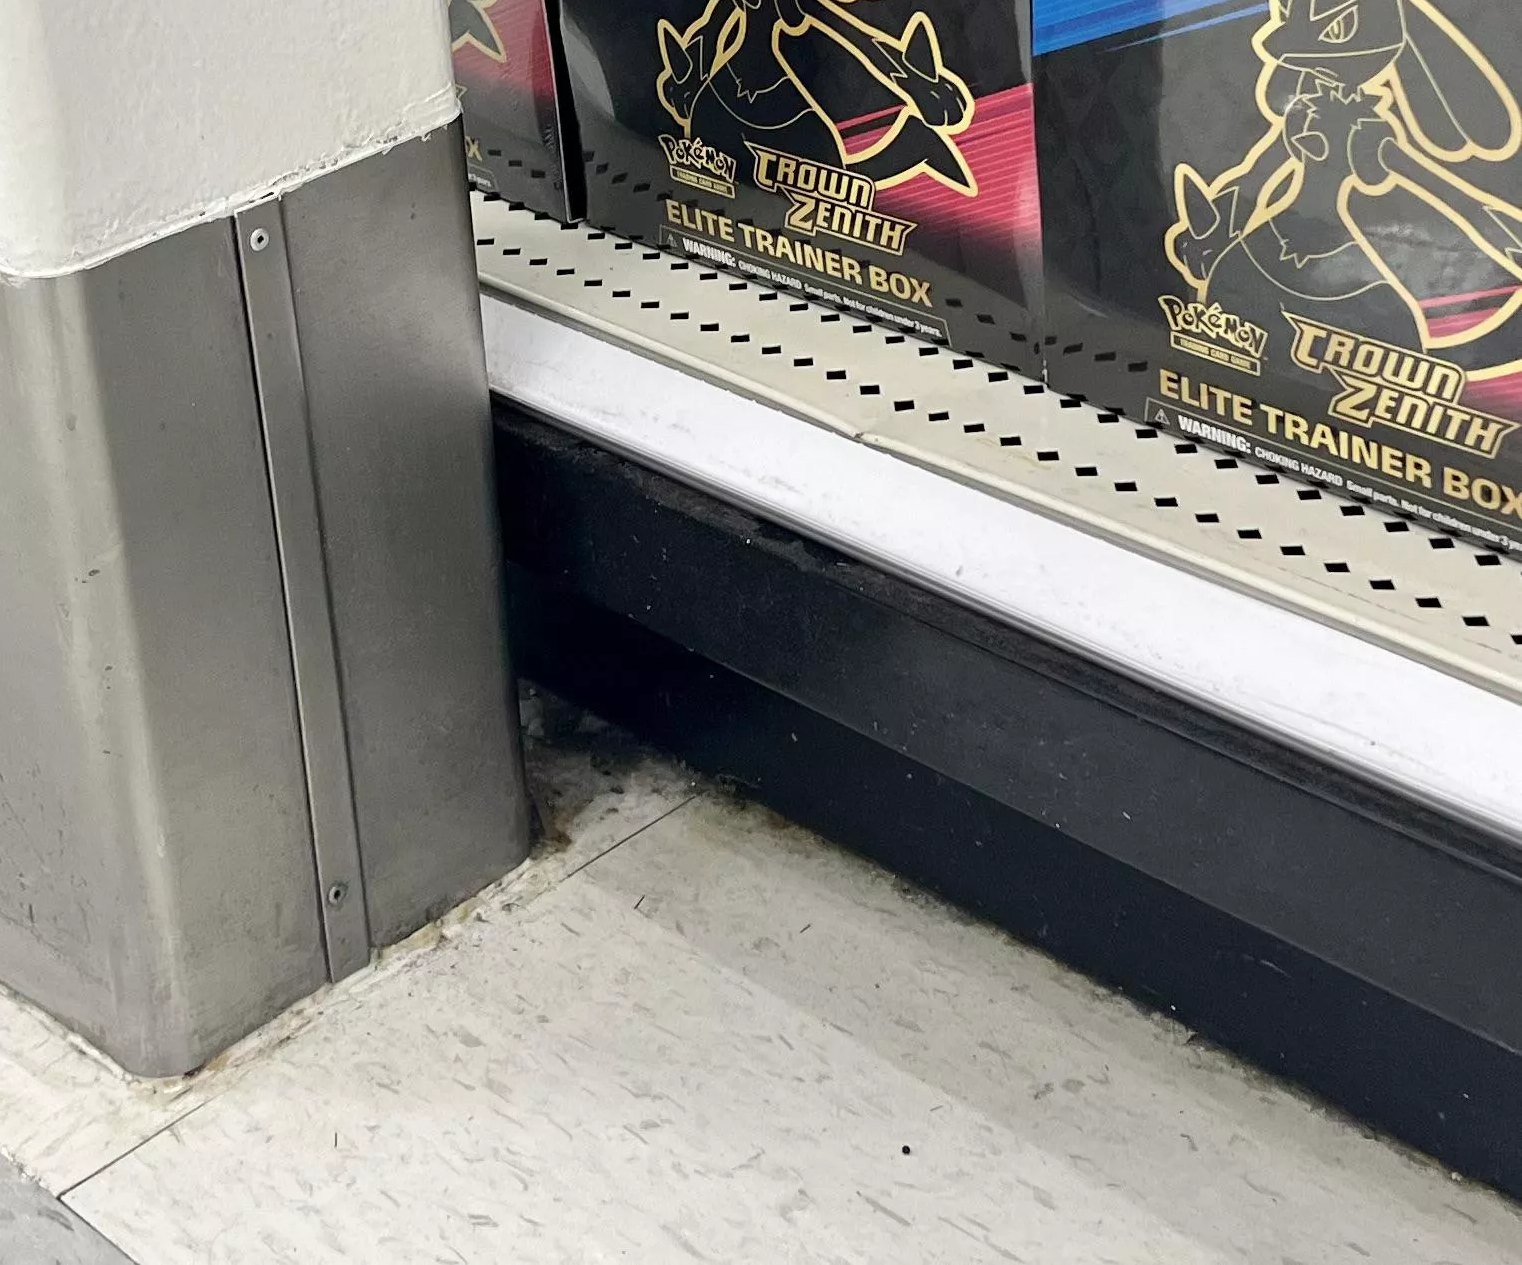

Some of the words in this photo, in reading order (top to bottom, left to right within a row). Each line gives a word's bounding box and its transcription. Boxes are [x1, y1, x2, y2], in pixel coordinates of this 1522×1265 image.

[756, 148, 873, 208] CROWN
[665, 198, 735, 243] ELITE
[737, 222, 863, 286] TRAINER
[868, 264, 933, 308] BOX
[682, 237, 737, 268] WARNING:
[786, 193, 908, 251] ZENITH
[1295, 321, 1464, 401] CROWN
[1159, 368, 1254, 426] ELITE
[1260, 402, 1432, 489] TRAINER
[1443, 466, 1522, 521] BOX
[1178, 414, 1252, 454] WARNING:
[1255, 446, 1300, 471] CHOKING
[1300, 462, 1343, 487] HAZARD
[1334, 374, 1507, 456] ZENITH
